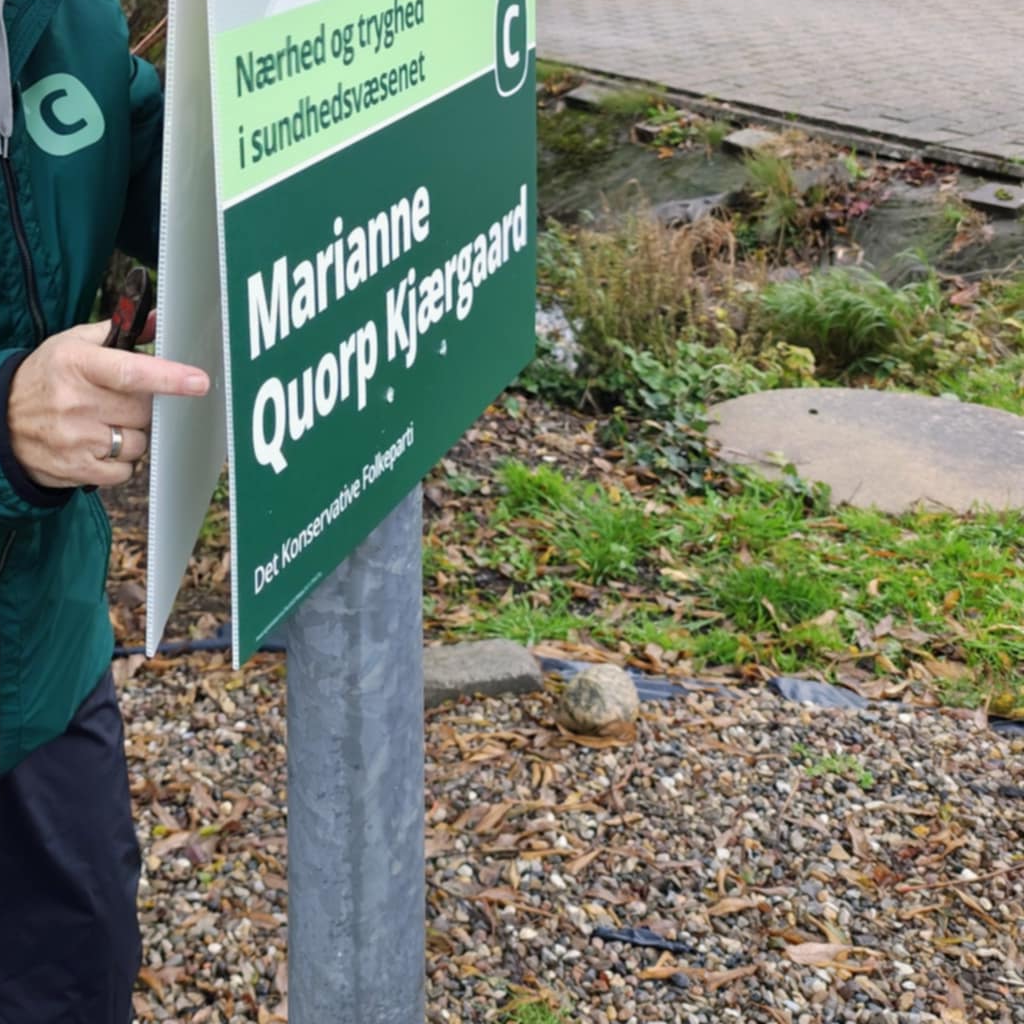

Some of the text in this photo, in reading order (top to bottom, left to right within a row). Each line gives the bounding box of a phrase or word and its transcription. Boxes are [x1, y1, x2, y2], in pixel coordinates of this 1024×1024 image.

[235, 23, 327, 98] Nærhed
[331, 23, 355, 66] og
[502, 4, 521, 69] C
[39, 88, 89, 136] C
[238, 51, 426, 170] i sundhedsvæsenet
[247, 186, 431, 361] Marianne
[252, 183, 528, 475] Quorp Kjærgaard
[254, 420, 415, 596] Det Konservative Folkeparti
